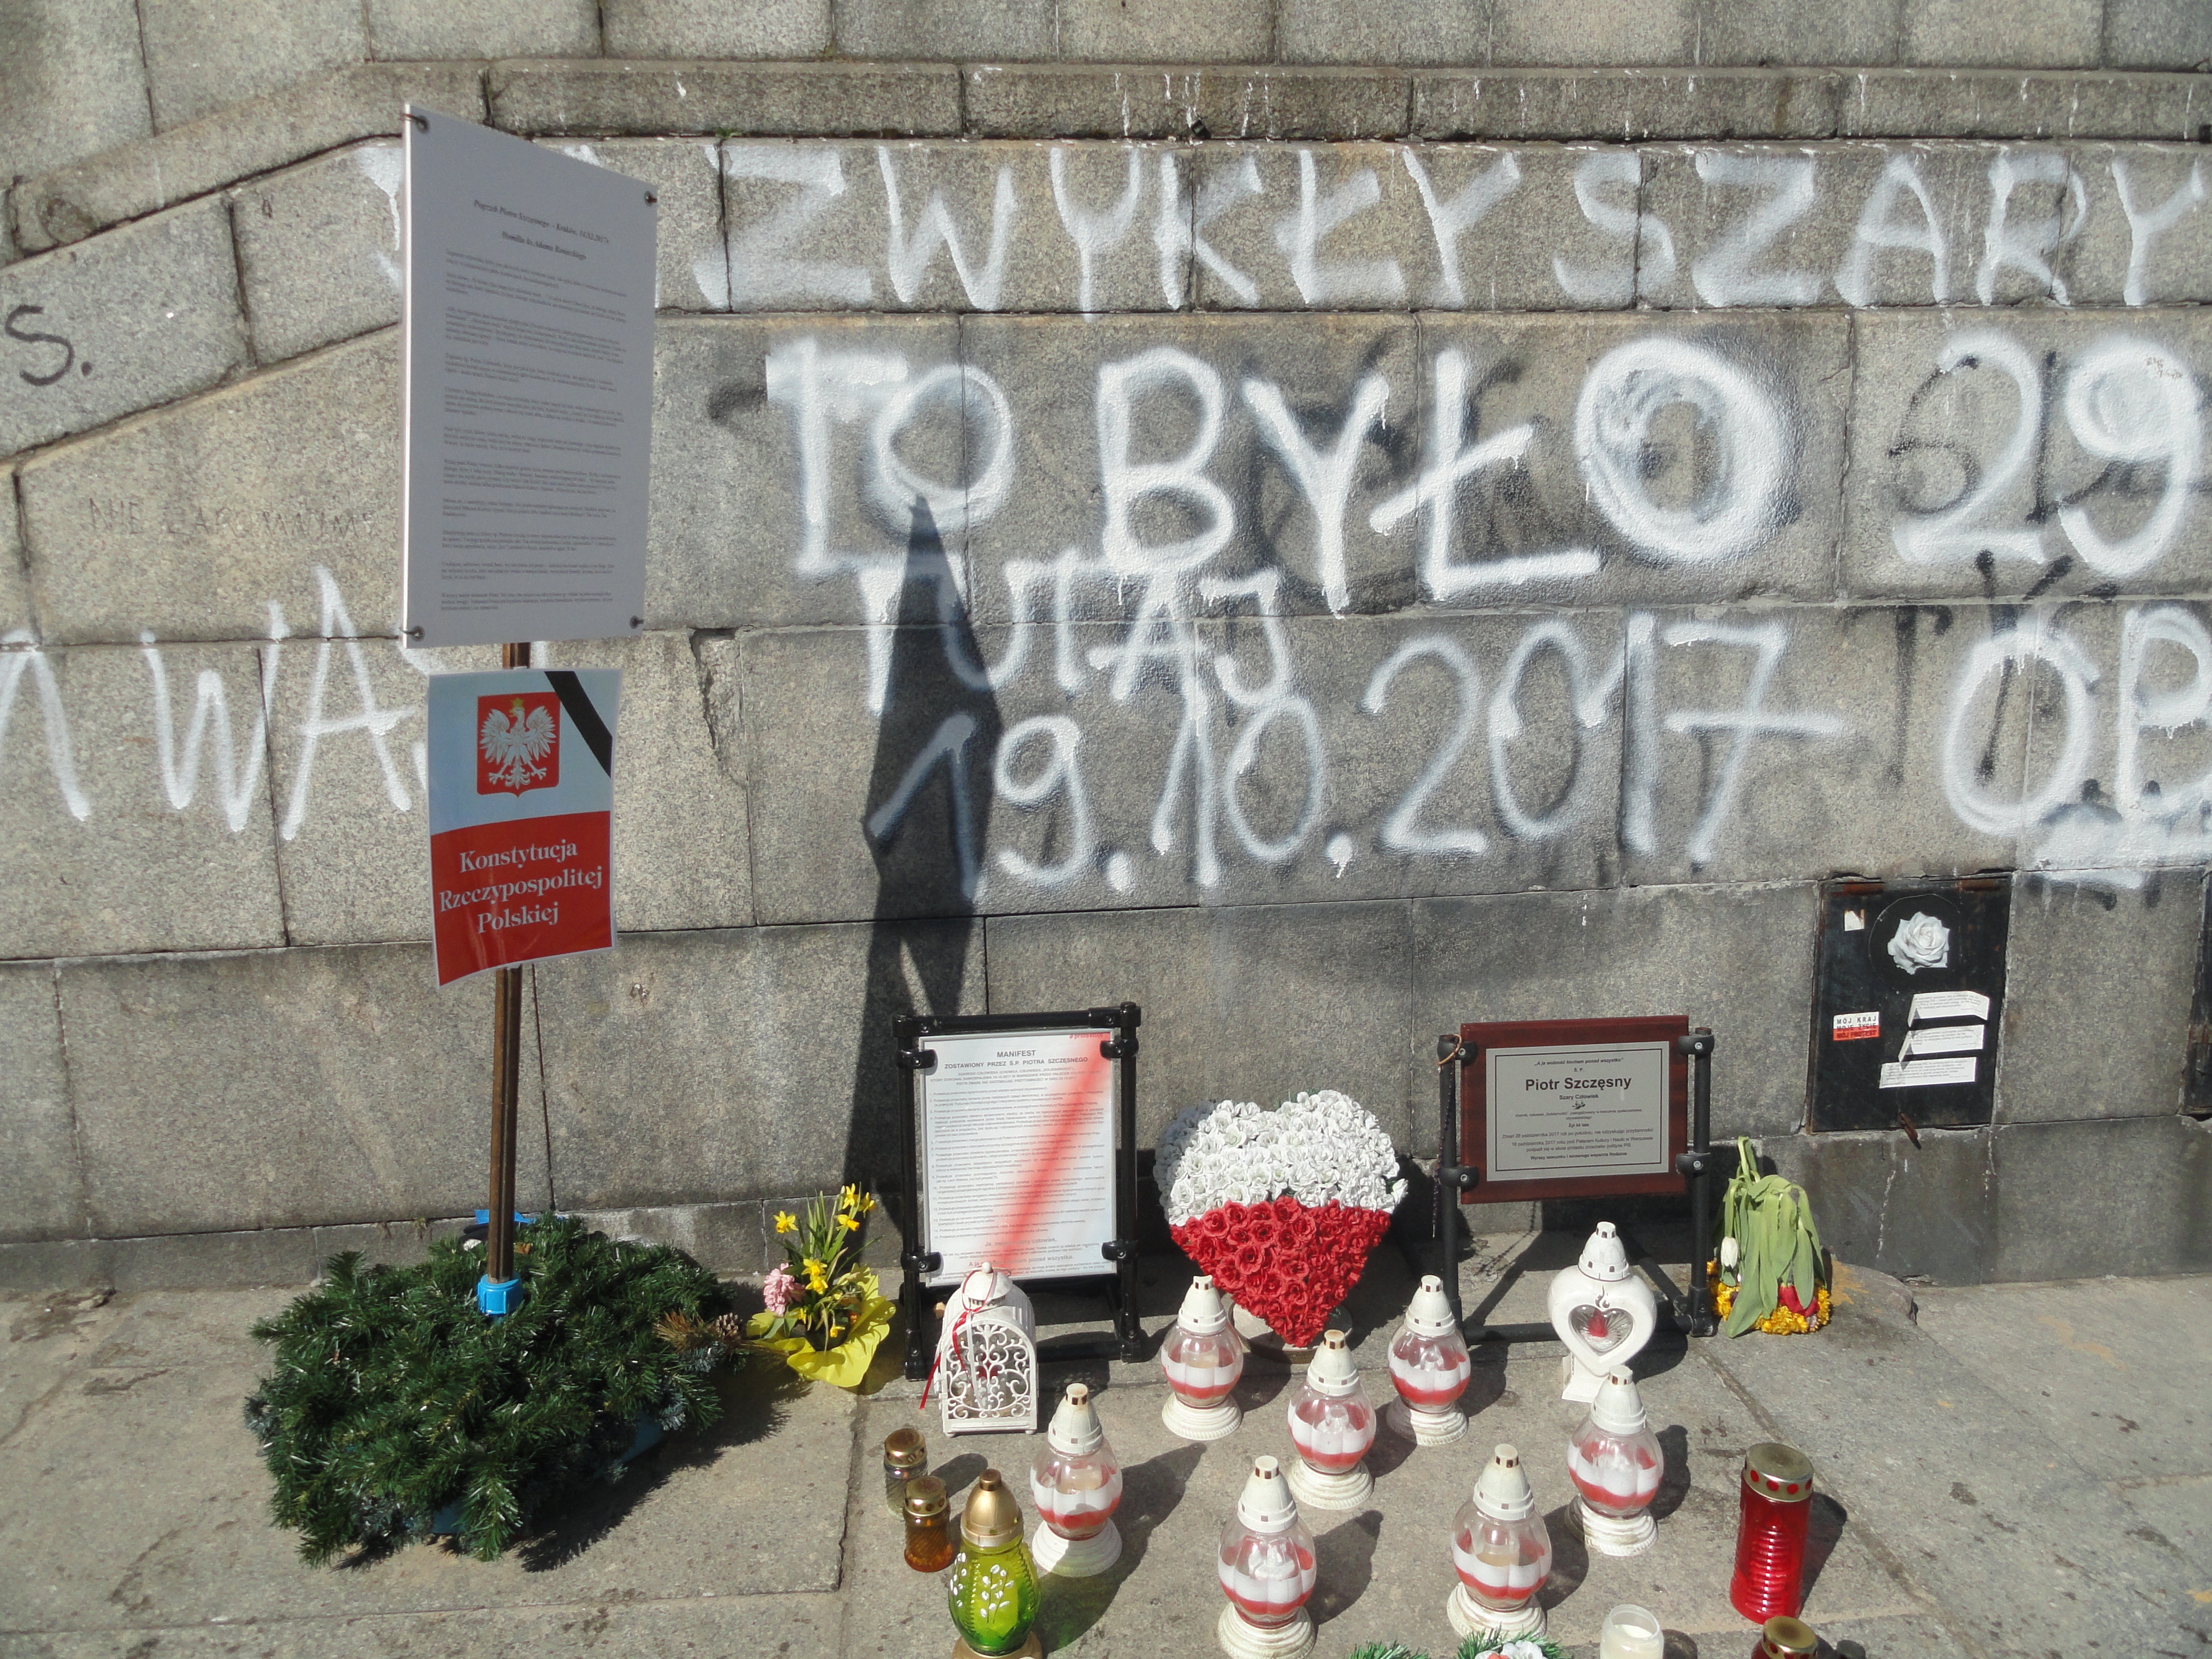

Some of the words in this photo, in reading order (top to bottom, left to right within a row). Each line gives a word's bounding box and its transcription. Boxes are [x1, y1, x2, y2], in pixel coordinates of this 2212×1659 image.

[692, 143, 1521, 318] ZWYKŁY
[1551, 148, 2206, 307] SZARY
[4, 304, 93, 387] S.
[766, 335, 1017, 578] TO
[1096, 335, 1793, 616] BYŁO
[1892, 329, 2203, 579] 29
[866, 610, 1846, 902] 19.10.2017
[459, 839, 578, 873] Konstytucja
[439, 866, 603, 912] Rzeczypospolitej
[477, 901, 559, 934] Polskiej
[996, 1050, 1036, 1058] MANIFEST
[1048, 1056, 1088, 1065] SZCZĘSNEGO
[1525, 1078, 1560, 1091] Piotr
[1564, 1077, 1632, 1091] Szczęsny
